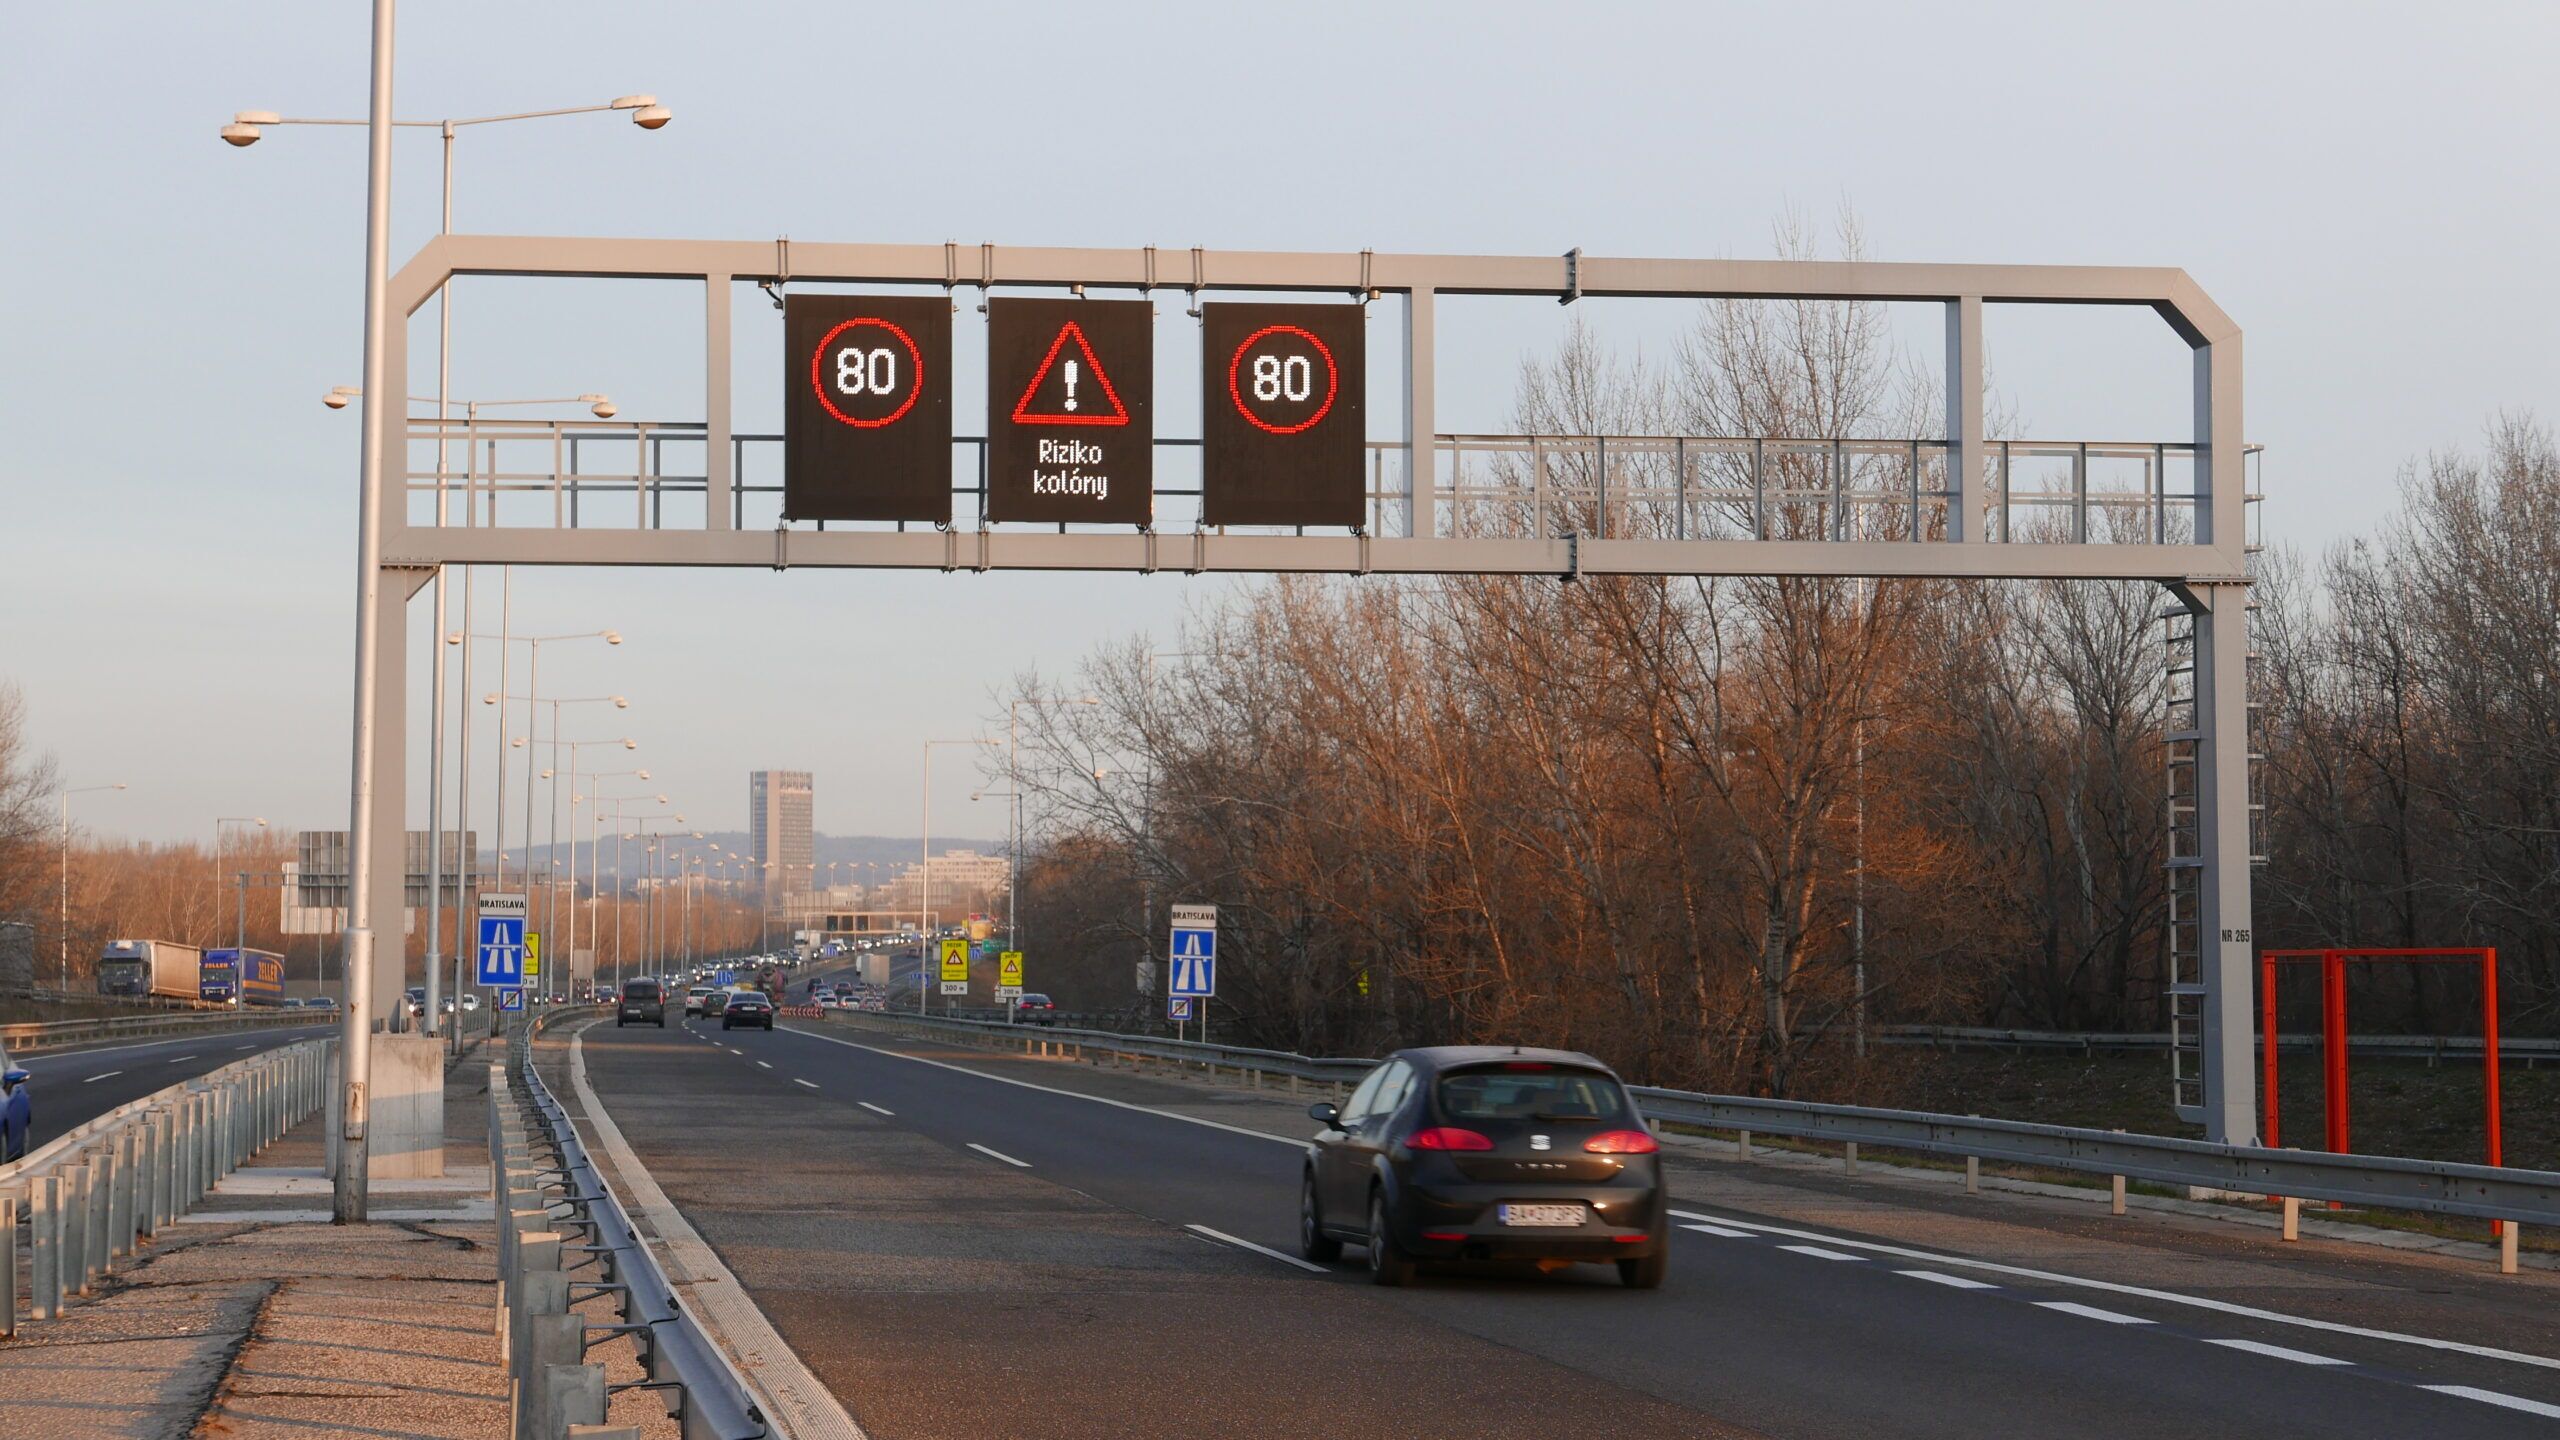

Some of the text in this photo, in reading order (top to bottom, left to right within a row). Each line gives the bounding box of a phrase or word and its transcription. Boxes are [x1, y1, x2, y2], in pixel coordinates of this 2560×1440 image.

[838, 348, 895, 394] 80
[1254, 356, 1310, 401] 80
[1040, 440, 1101, 464] Riziko
[1034, 470, 1107, 500] kolóny
[480, 900, 525, 909] BRATISLAVA
[1172, 912, 1215, 920] BRATISLAVA
[2221, 929, 2250, 942] NR 265
[258, 960, 278, 982] ZELLER
